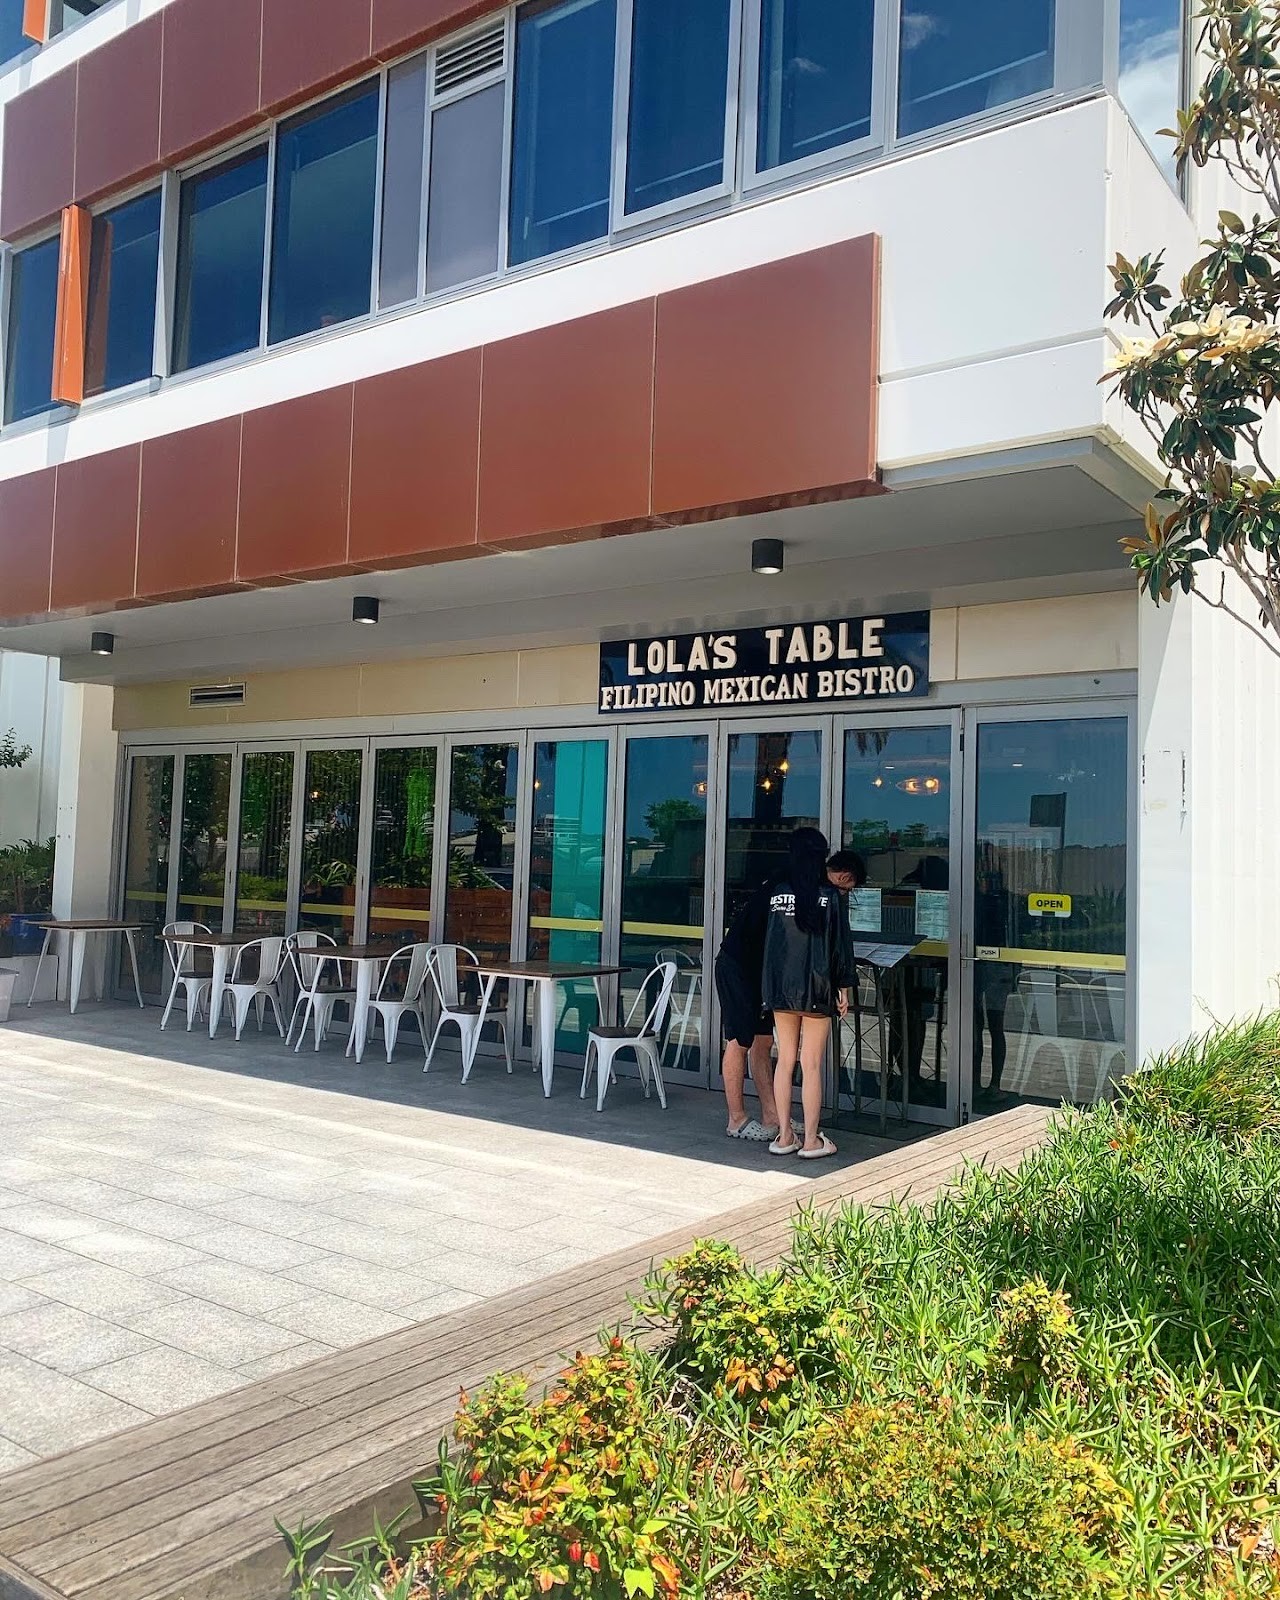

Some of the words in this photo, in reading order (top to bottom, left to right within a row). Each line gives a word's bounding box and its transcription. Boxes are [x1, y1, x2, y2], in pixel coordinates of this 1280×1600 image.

[627, 633, 738, 676] LOLA'S
[765, 618, 886, 665] TABLE
[600, 681, 696, 710] FILIPINO
[703, 671, 809, 704] MEXICAN
[817, 664, 916, 698] BISTRO
[1036, 899, 1063, 909] OPEN
